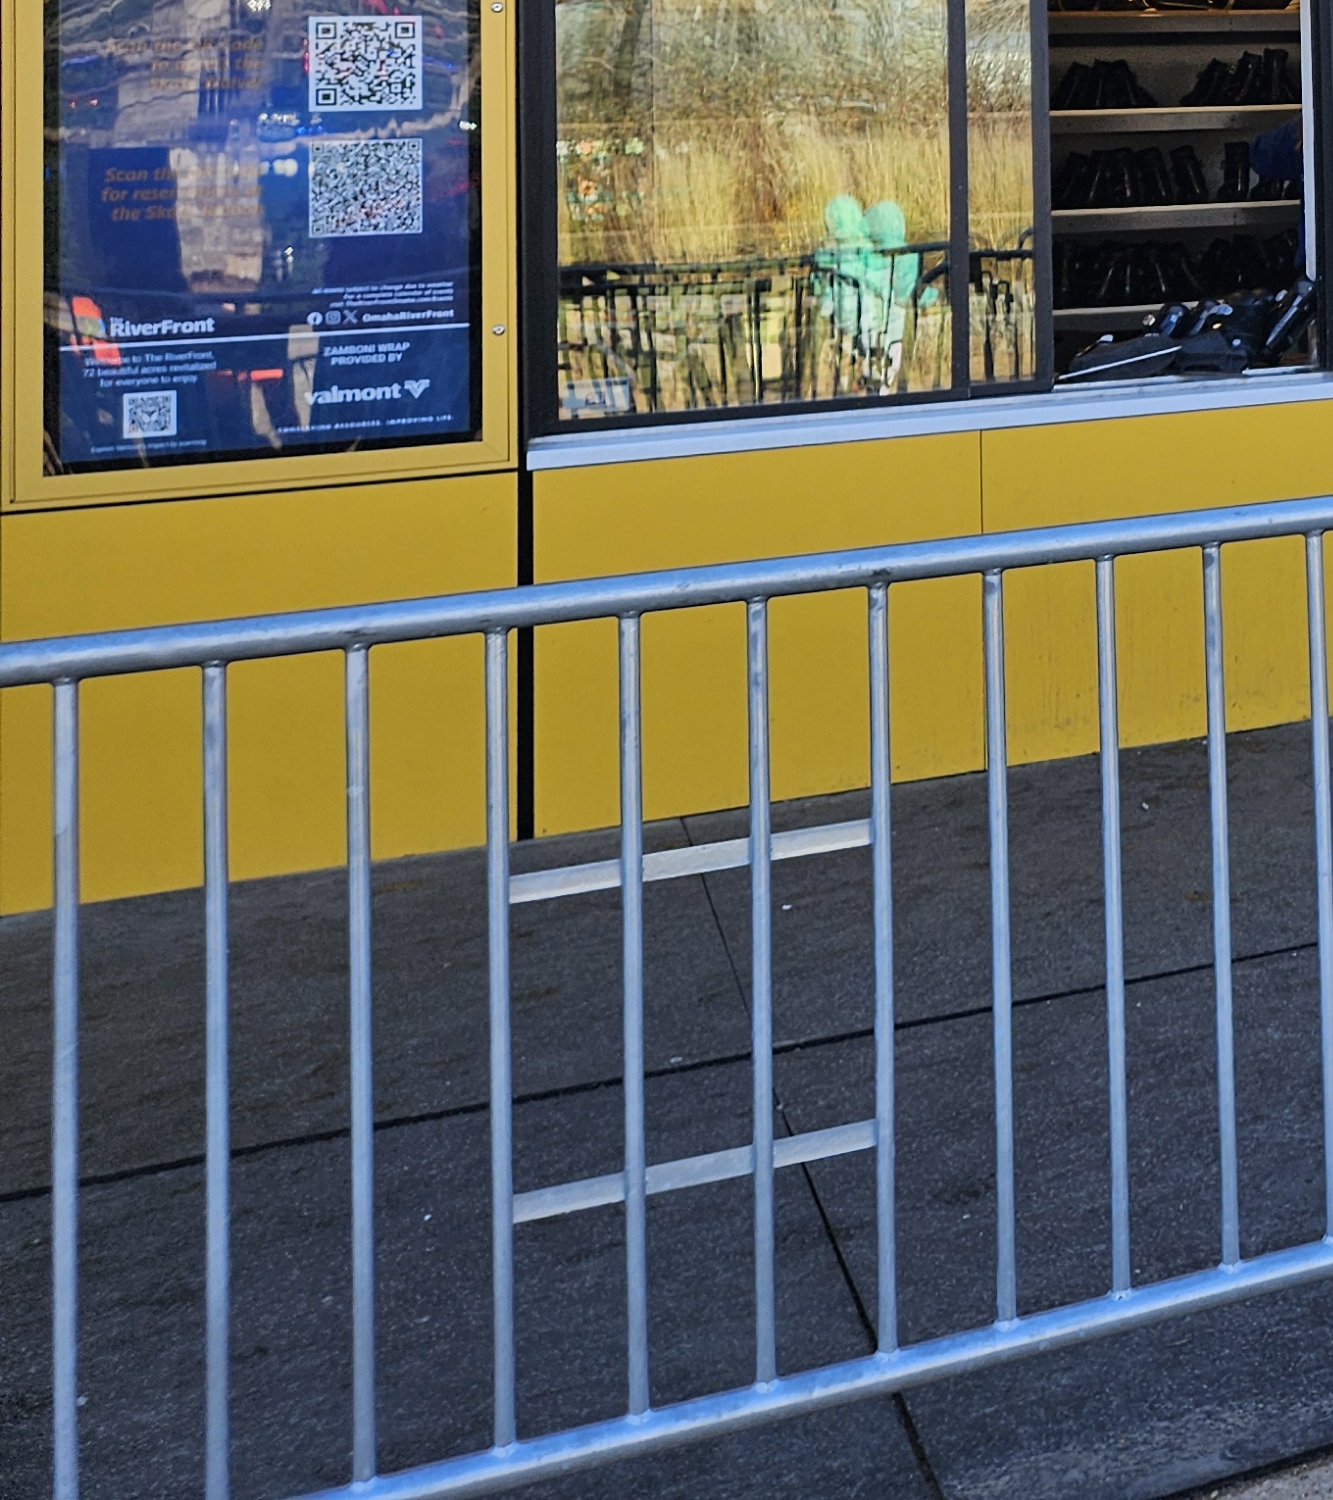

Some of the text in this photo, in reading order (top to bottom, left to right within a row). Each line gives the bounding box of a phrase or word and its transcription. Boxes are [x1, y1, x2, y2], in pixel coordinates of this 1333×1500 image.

[104, 166, 148, 182] Scan
[101, 187, 127, 202] for
[111, 205, 141, 220] the
[361, 309, 455, 323] OmahaRiverFront
[110, 318, 216, 337] RiverFront
[323, 342, 411, 356] ZAMBONI WRAP
[330, 352, 403, 365] PROVIDED BY
[304, 382, 402, 406] valmont
